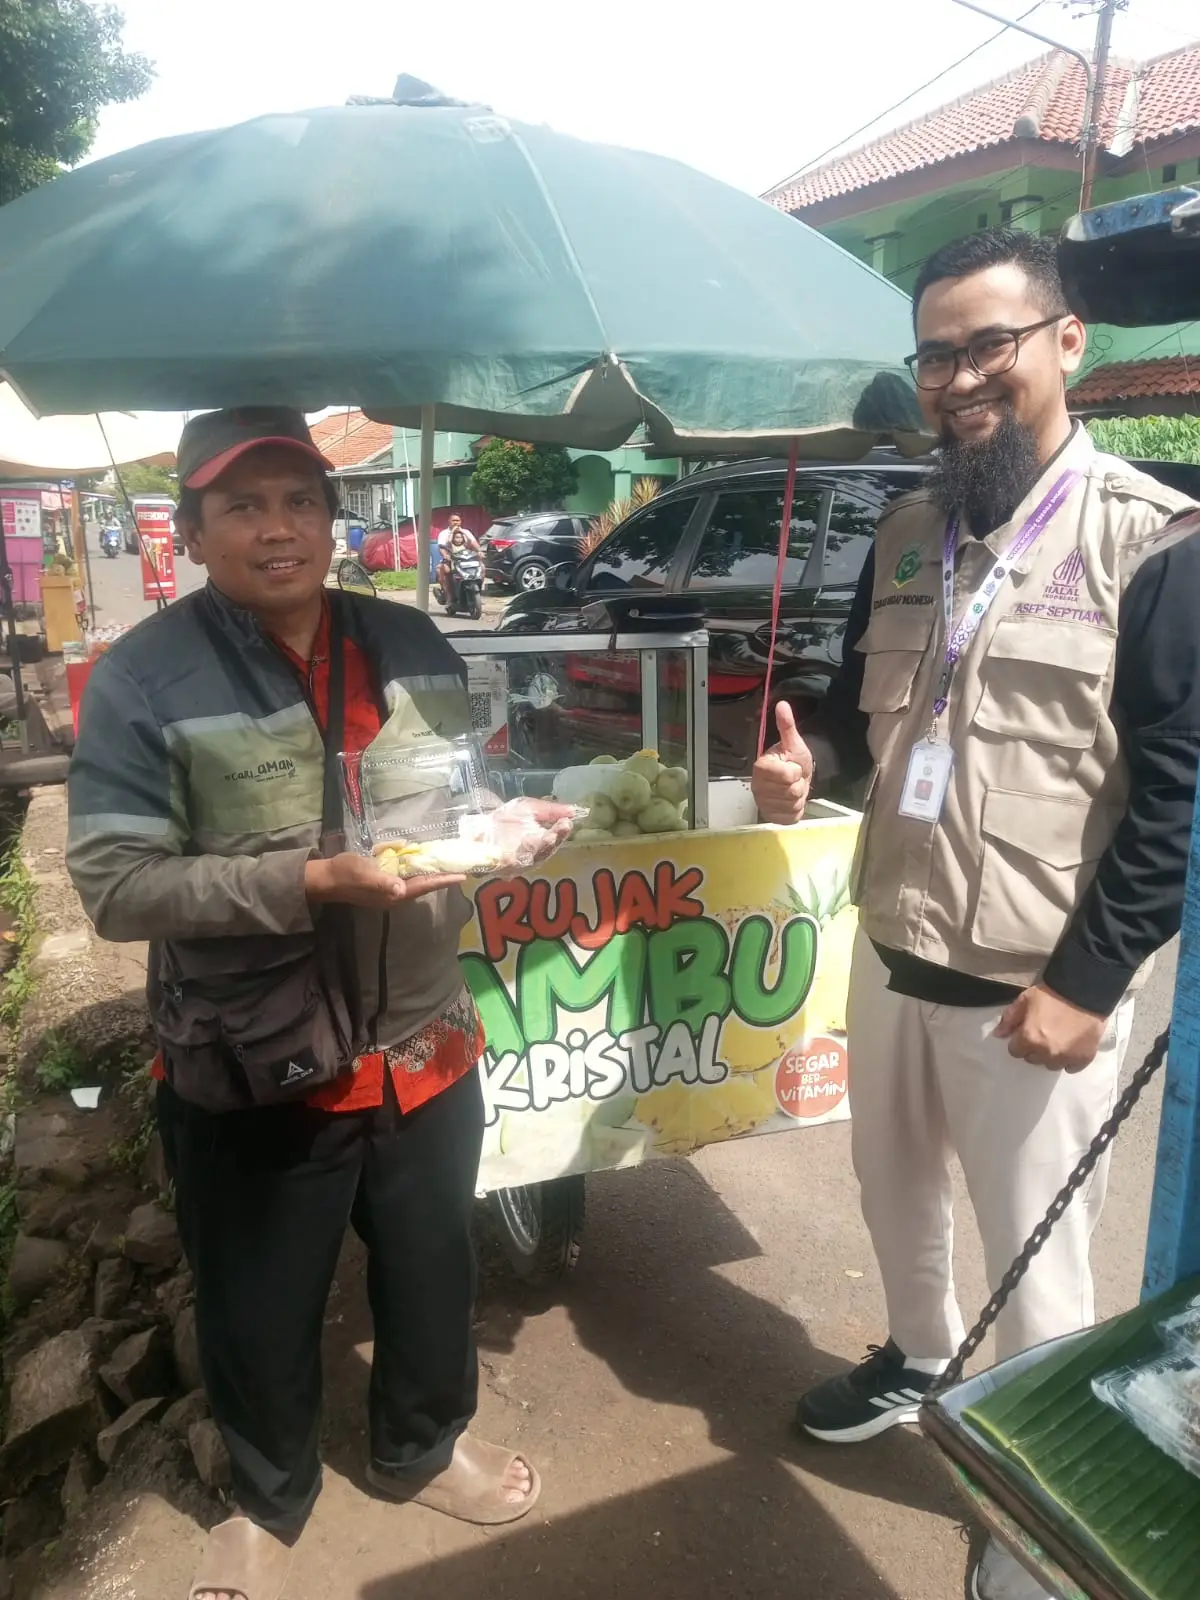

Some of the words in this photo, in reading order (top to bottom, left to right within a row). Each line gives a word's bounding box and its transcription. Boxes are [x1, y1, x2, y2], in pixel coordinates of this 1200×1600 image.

[1045, 585, 1080, 597] HALAL
[1014, 602, 1046, 615] ASEP
[1046, 605, 1103, 625] SEPTIAN
[474, 860, 704, 961] RUJAK
[785, 1051, 840, 1074] SEGAR
